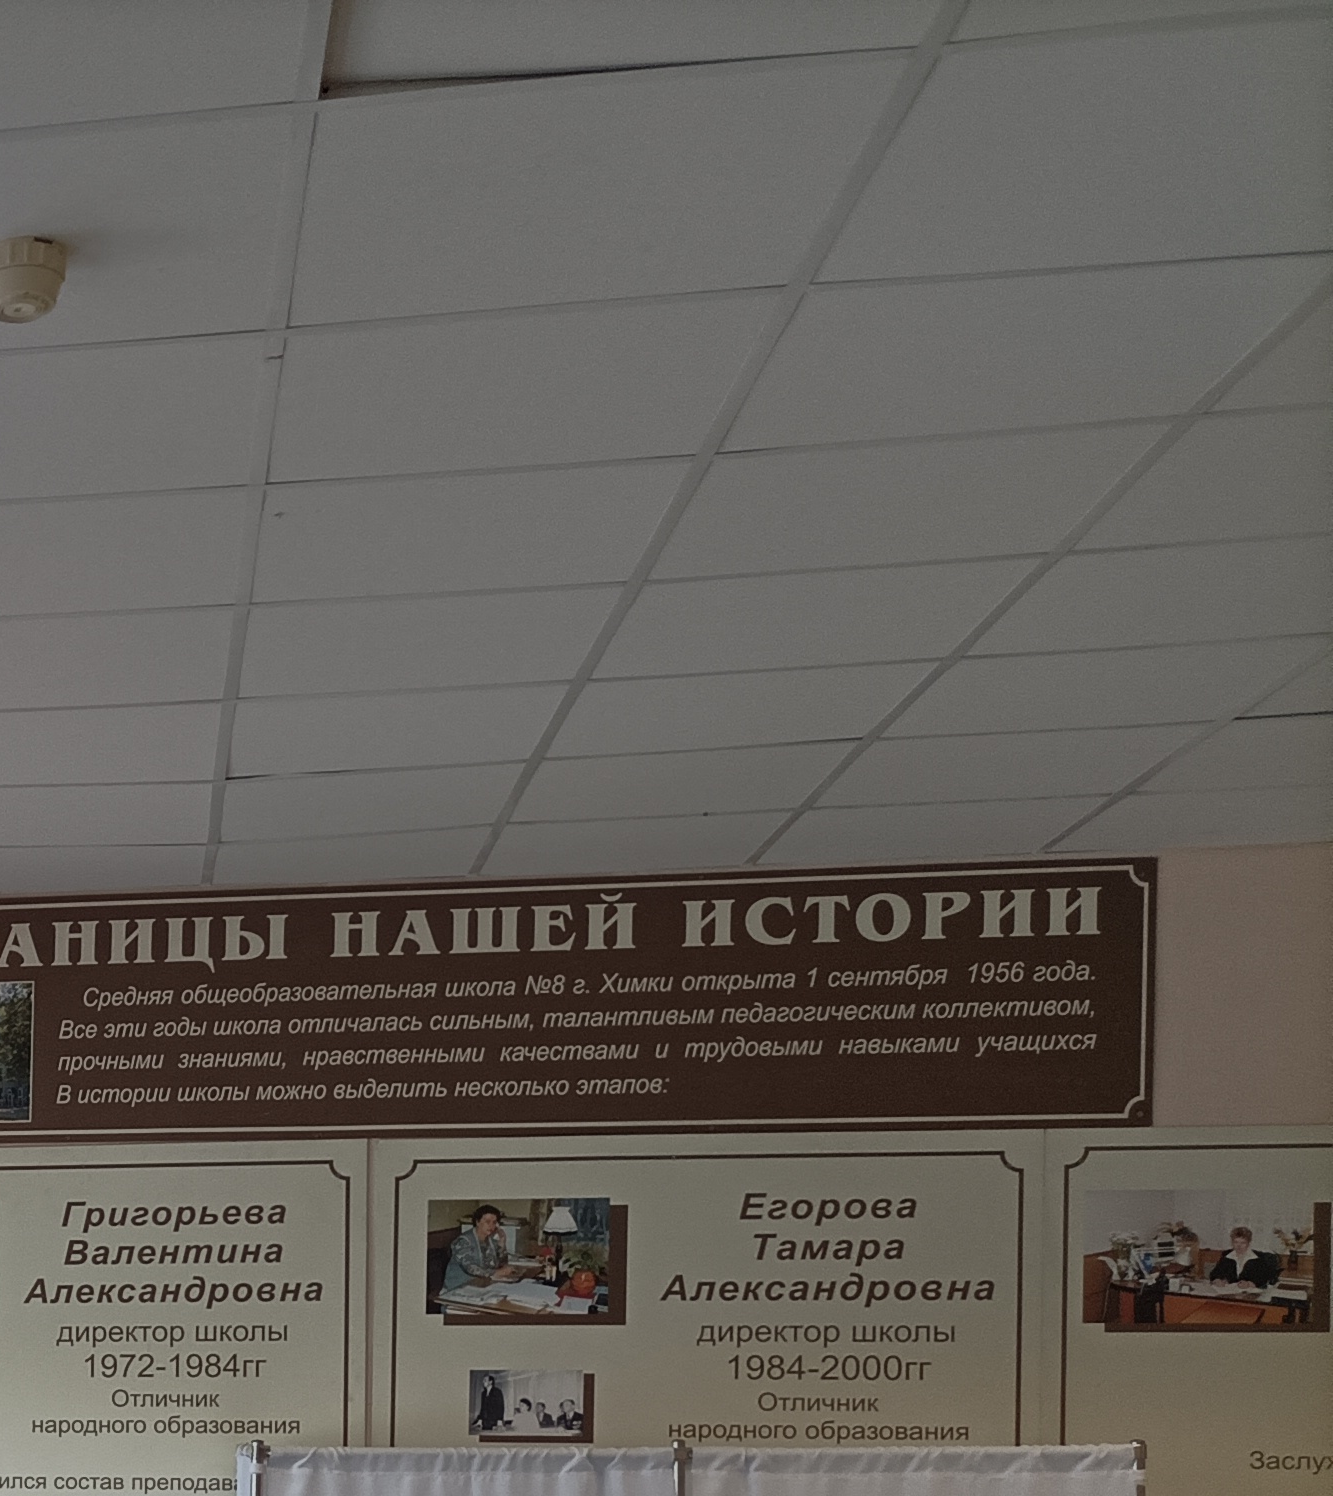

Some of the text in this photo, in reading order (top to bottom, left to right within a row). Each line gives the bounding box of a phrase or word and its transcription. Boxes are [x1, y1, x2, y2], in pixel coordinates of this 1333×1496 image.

[329, 892, 638, 958] НАШЕЙ
[681, 886, 1102, 948] ИСТОРИИ
[82, 959, 1096, 1012] Средняя общеобразовательная школа №8 г. Химки открыта 1 сентября 1956 года.
[58, 999, 1095, 1040] Все эти годы школа отличалась сильным, талантливым педагогическим коллективом,
[57, 1033, 1098, 1076] прочными знаниями, нравственными качествами и трудовыми навыками учащихся
[55, 1077, 670, 1108] В истории школы можно выделить несколько этапов:
[61, 1200, 287, 1234] Григорьева
[739, 1192, 917, 1227] Егорова
[63, 1239, 283, 1266] Валентина
[753, 1233, 905, 1268] Тамара
[23, 1275, 323, 1310] Александровна
[660, 1272, 995, 1309] Александровна
[55, 1324, 288, 1349] директор школы
[696, 1324, 956, 1349] директор школы
[84, 1353, 267, 1379] 1972-1984гг
[728, 1354, 932, 1382] 1984-2000гг
[111, 1388, 220, 1408] Отличник
[757, 1391, 879, 1413] Отличник
[31, 1414, 301, 1439] народного образования
[668, 1419, 970, 1446] народного образования
[53, 1476, 125, 1491] состав
[131, 1476, 238, 1495] преподав
